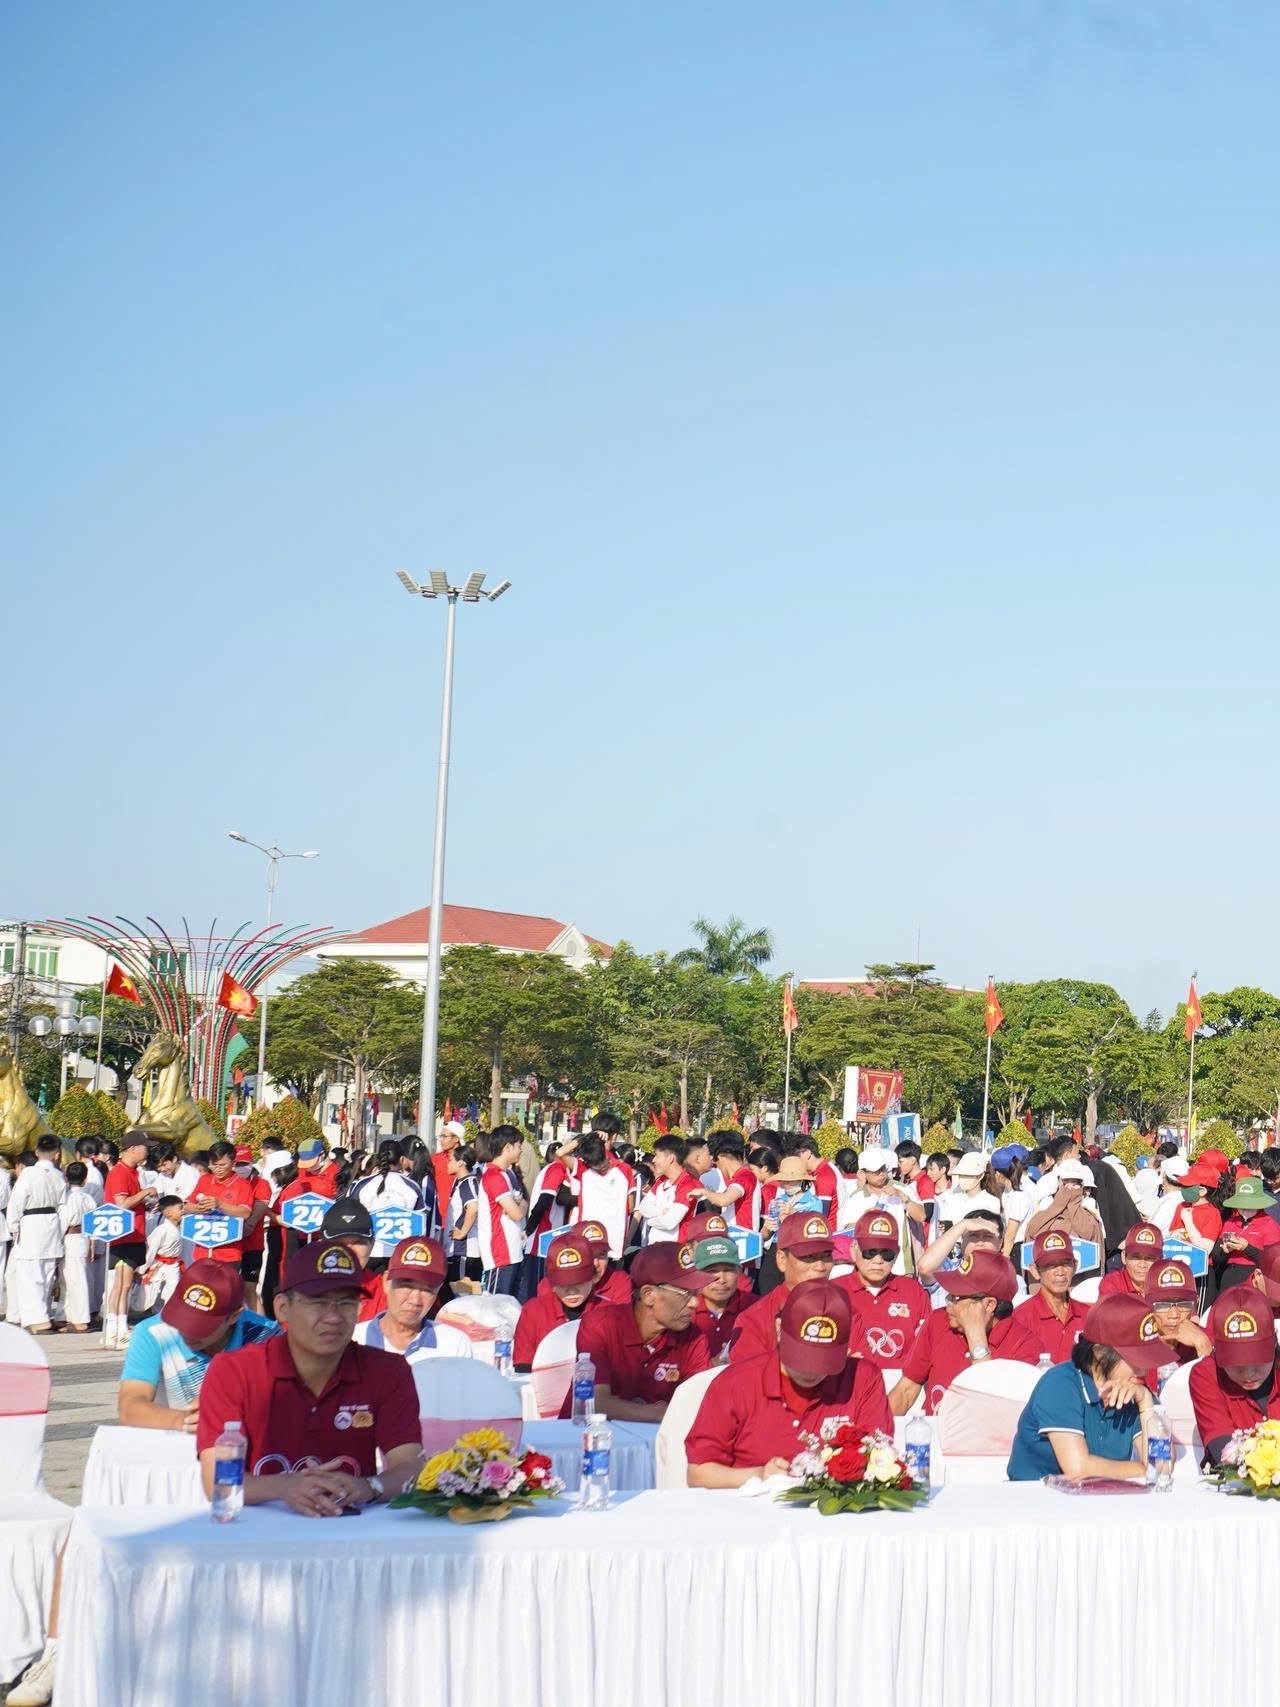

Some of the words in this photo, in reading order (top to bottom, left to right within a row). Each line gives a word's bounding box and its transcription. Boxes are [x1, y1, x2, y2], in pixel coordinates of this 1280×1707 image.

[93, 1216, 124, 1237] 26
[292, 1206, 325, 1226] 24
[192, 1221, 229, 1242] 25
[376, 1218, 412, 1239] 23
